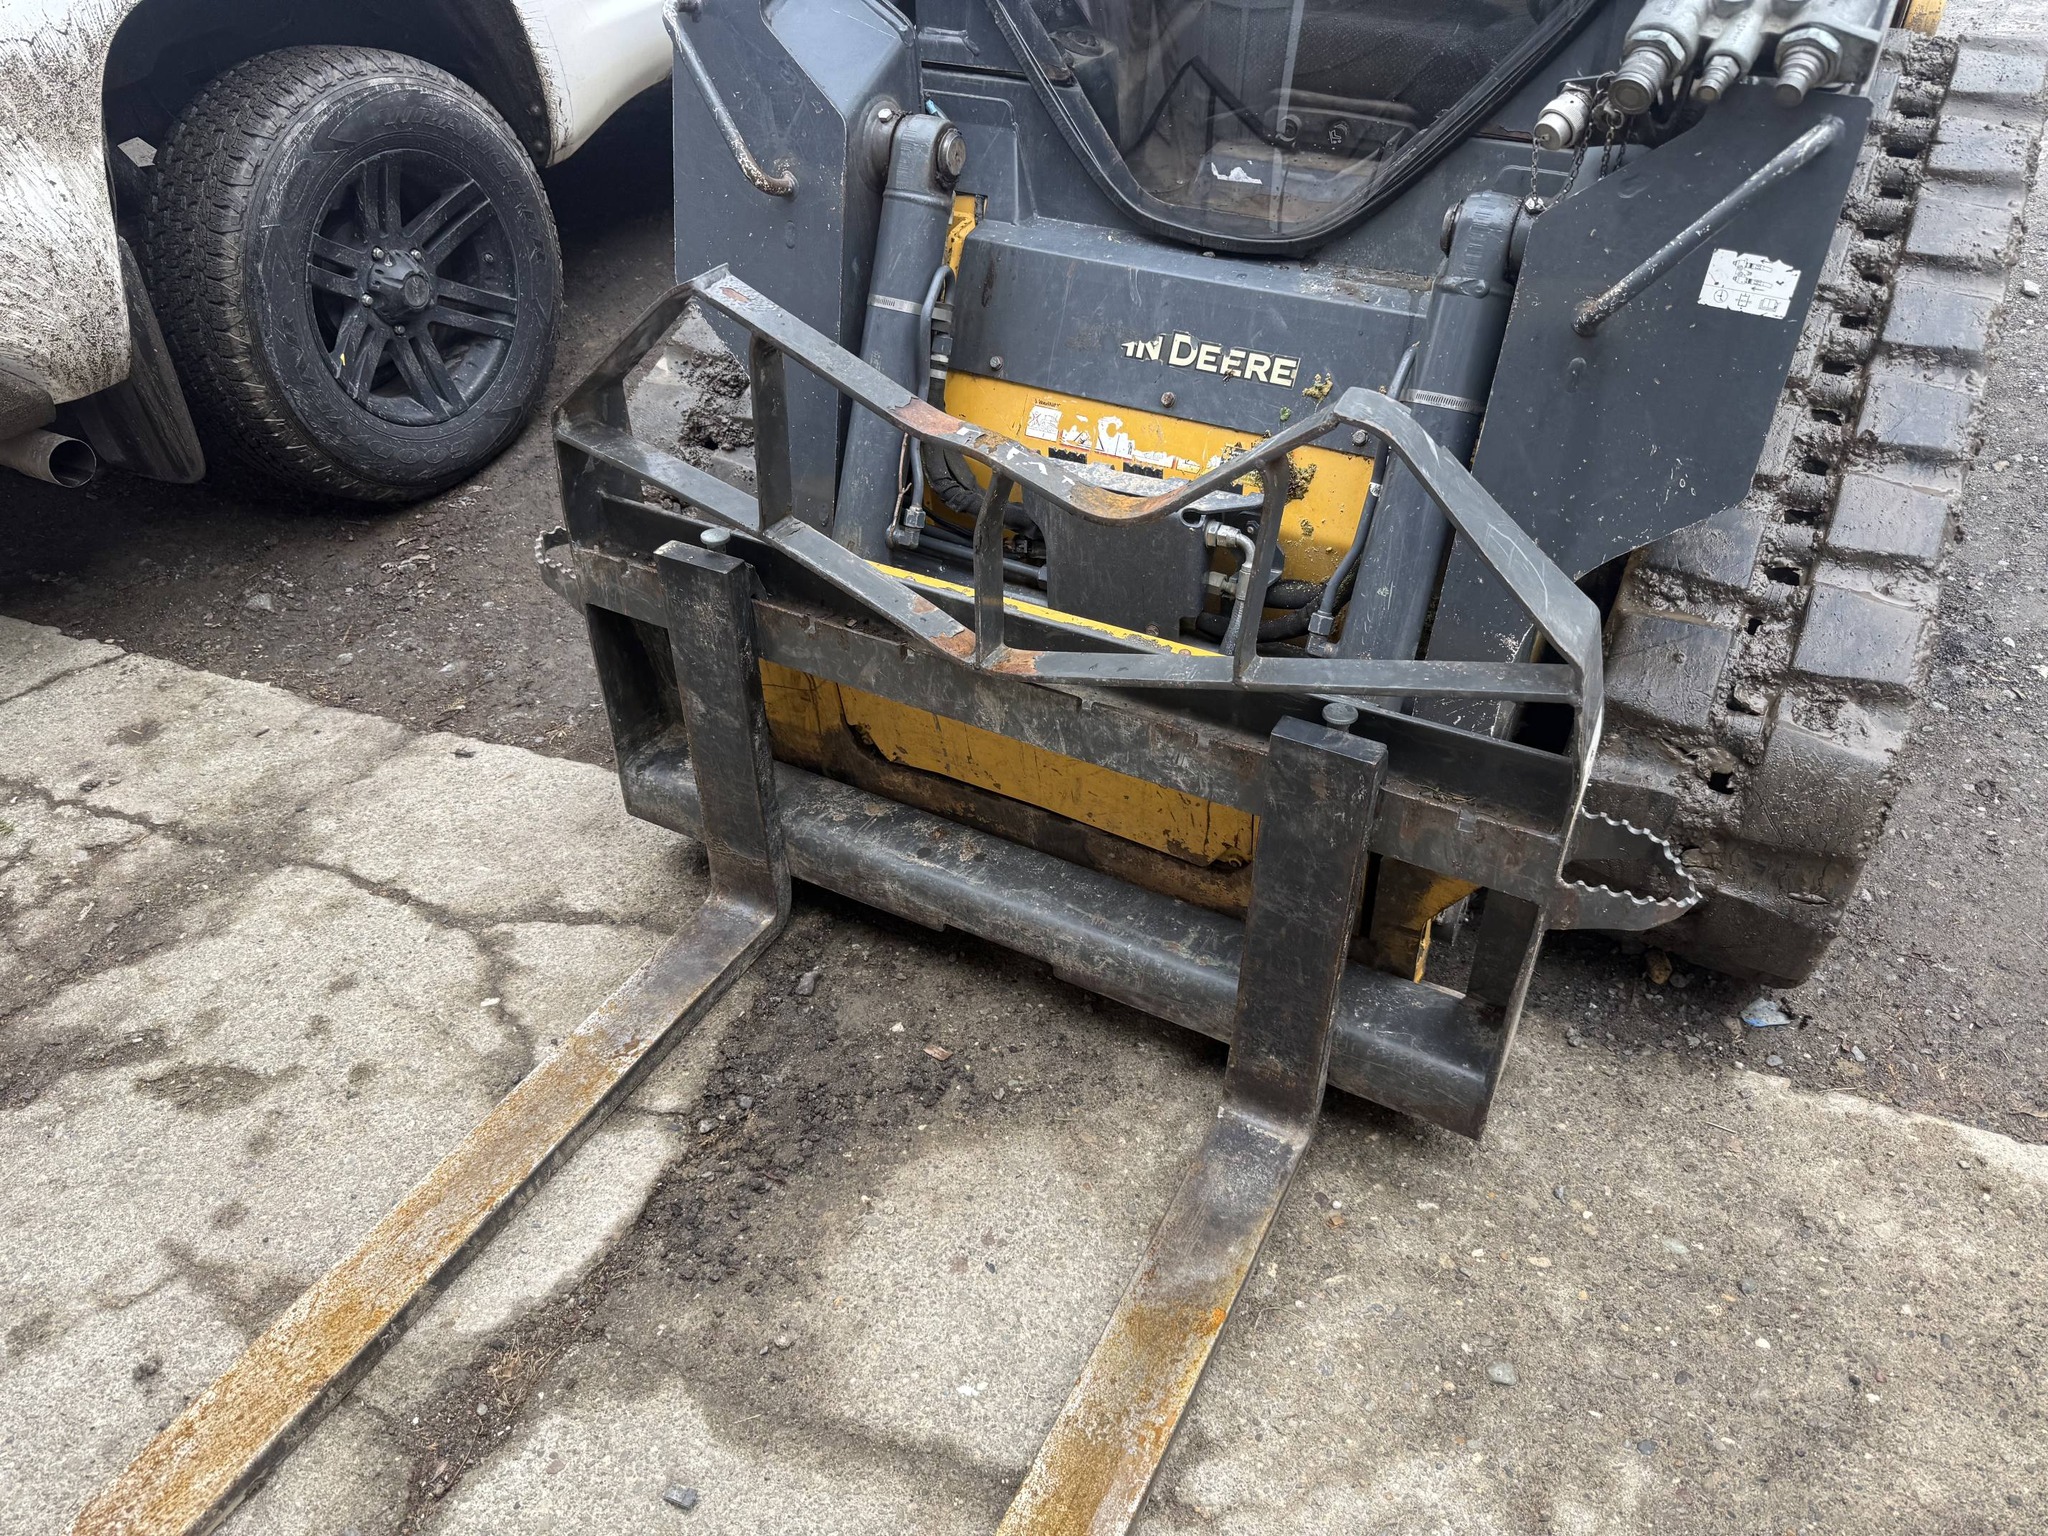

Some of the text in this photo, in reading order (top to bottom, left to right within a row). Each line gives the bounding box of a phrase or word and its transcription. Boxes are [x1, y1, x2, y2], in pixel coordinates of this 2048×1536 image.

[377, 106, 547, 265] WRANGLER
[280, 313, 474, 466] GOODYEAR
[1169, 333, 1297, 387] DEERE
